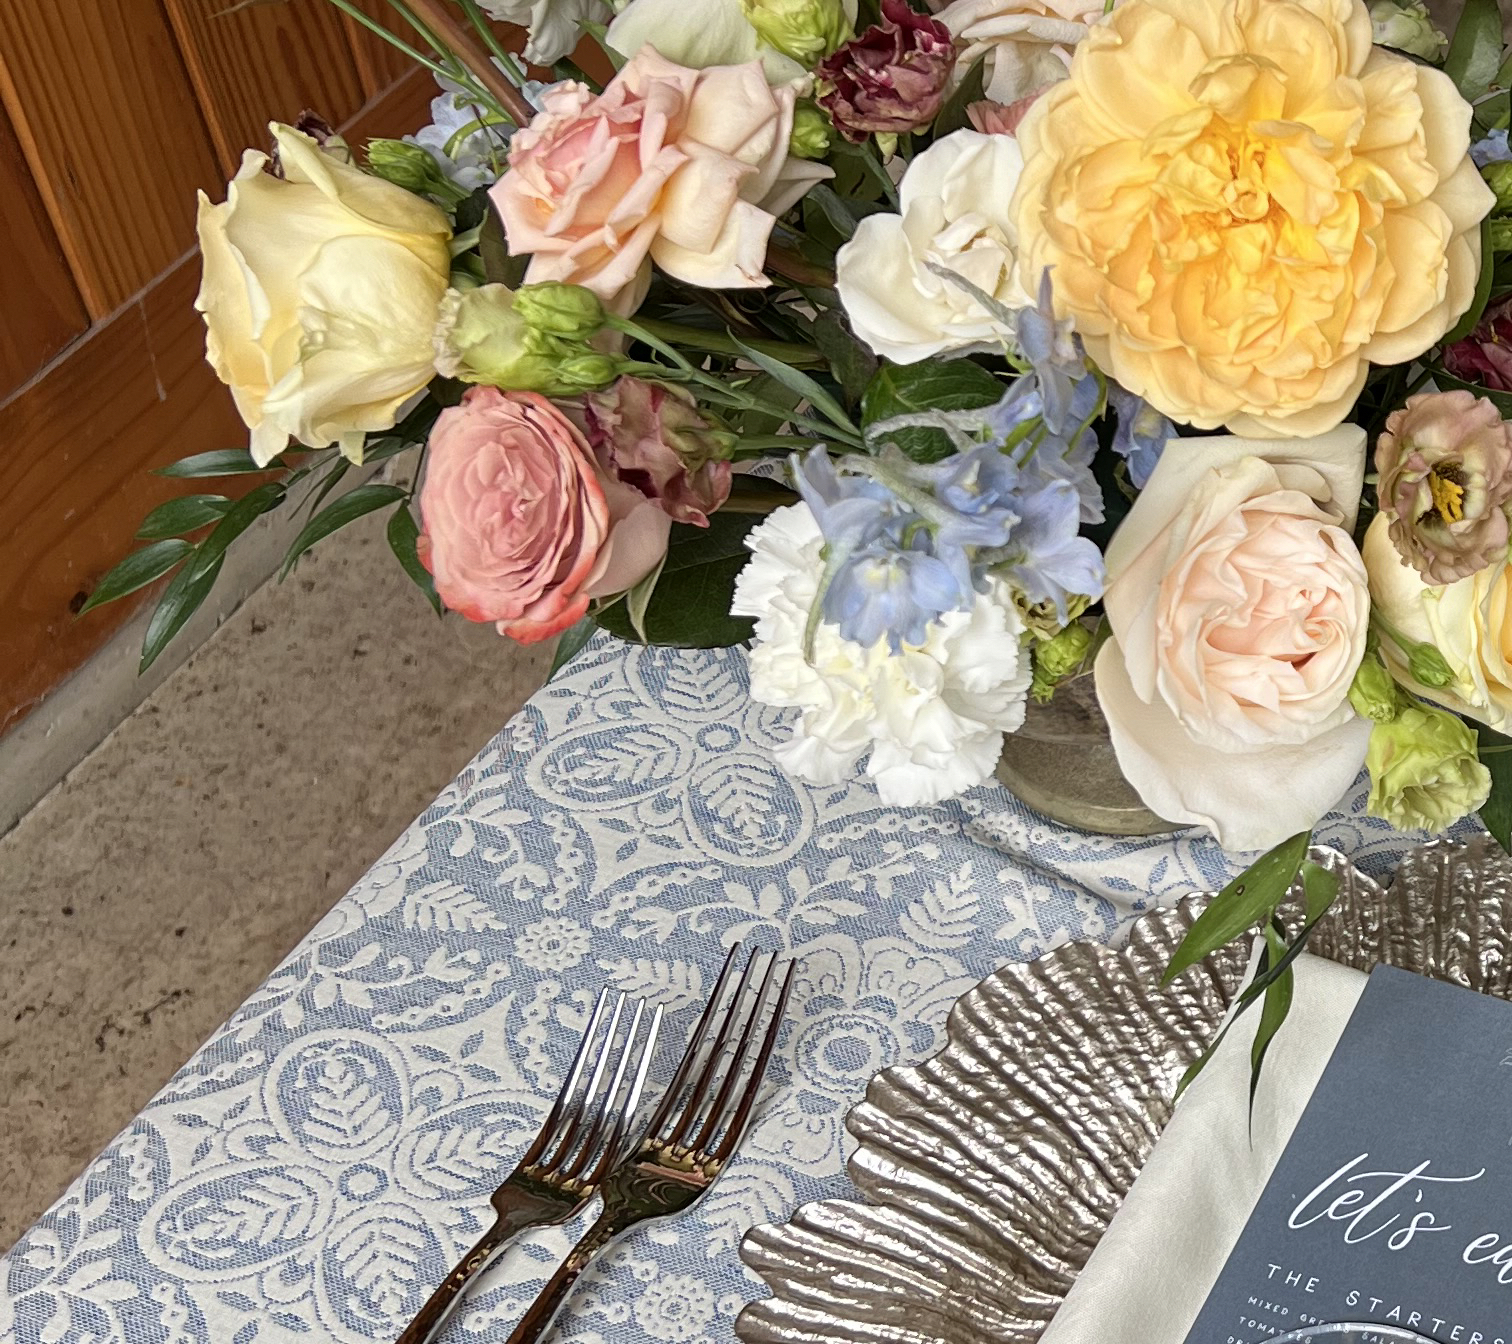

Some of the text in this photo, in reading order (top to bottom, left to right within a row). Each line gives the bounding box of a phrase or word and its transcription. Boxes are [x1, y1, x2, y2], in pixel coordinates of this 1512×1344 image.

[1287, 1152, 1486, 1251] let's
[1267, 1262, 1321, 1294] THE
[1247, 1295, 1289, 1316] MIXED
